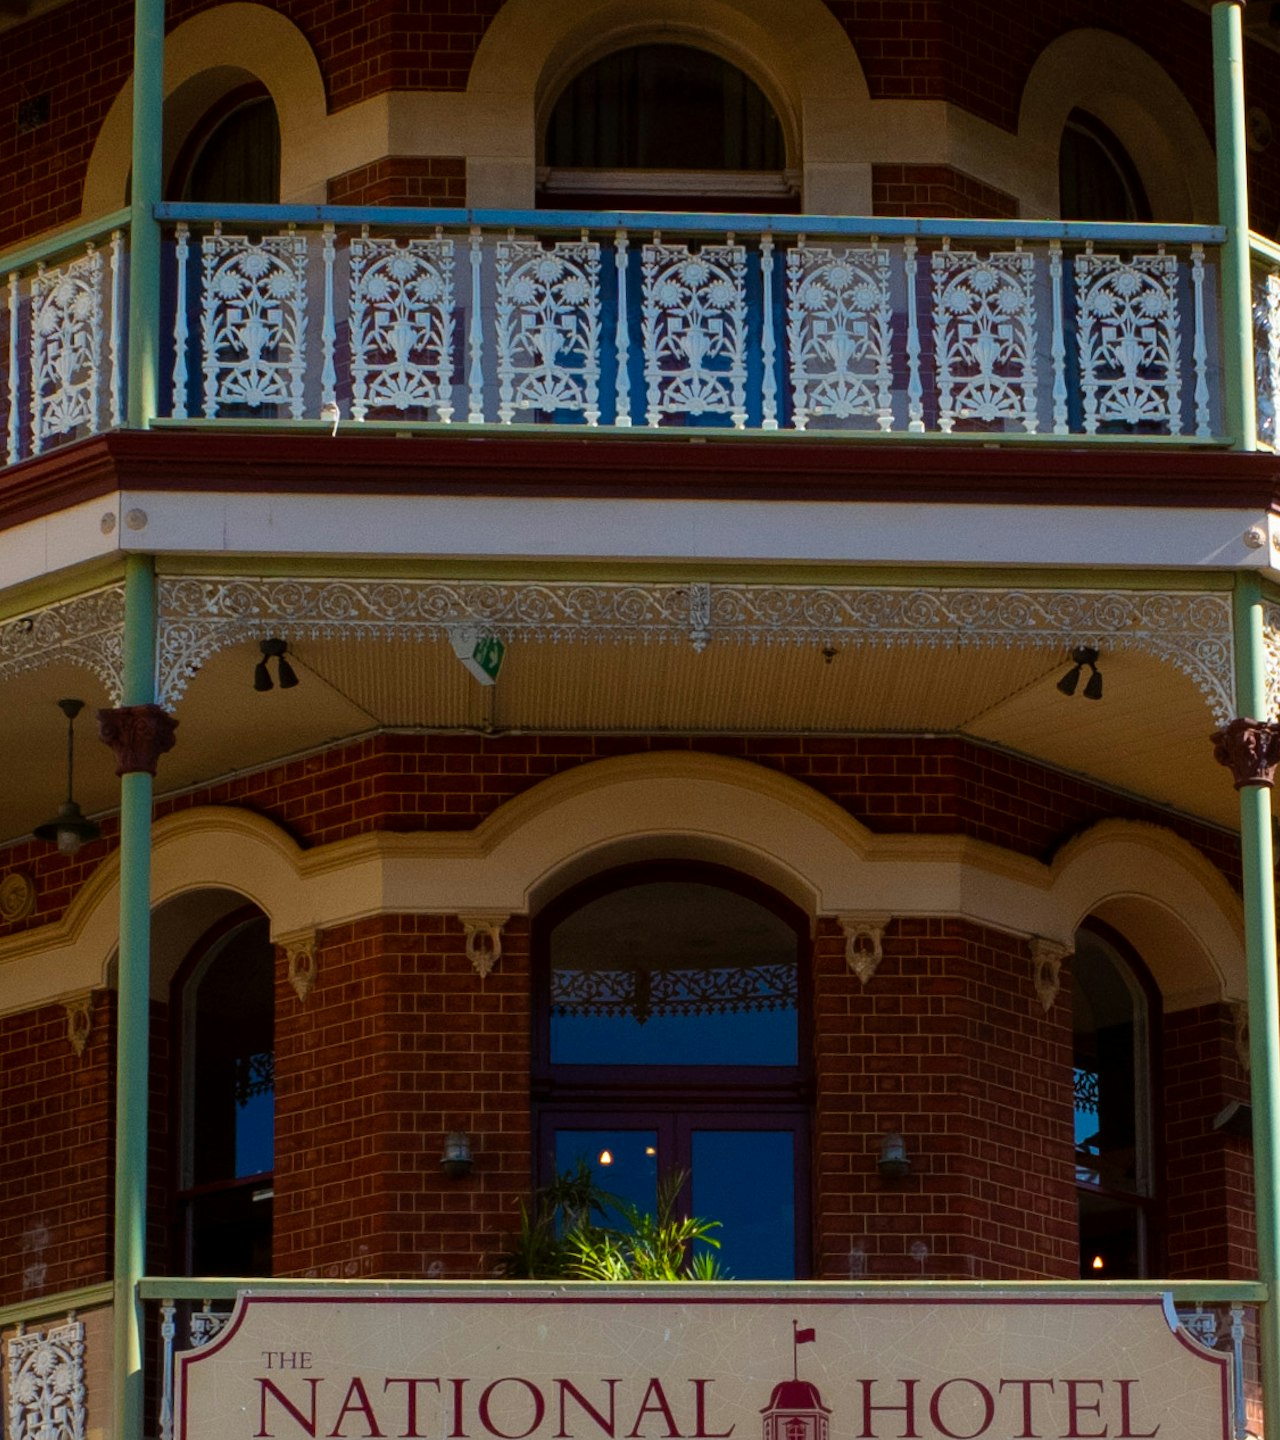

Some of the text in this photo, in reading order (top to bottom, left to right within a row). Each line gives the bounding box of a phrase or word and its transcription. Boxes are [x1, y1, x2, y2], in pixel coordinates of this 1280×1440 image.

[261, 1351, 312, 1370] THE
[252, 1376, 1161, 1440] NATIONAL HOTEL
